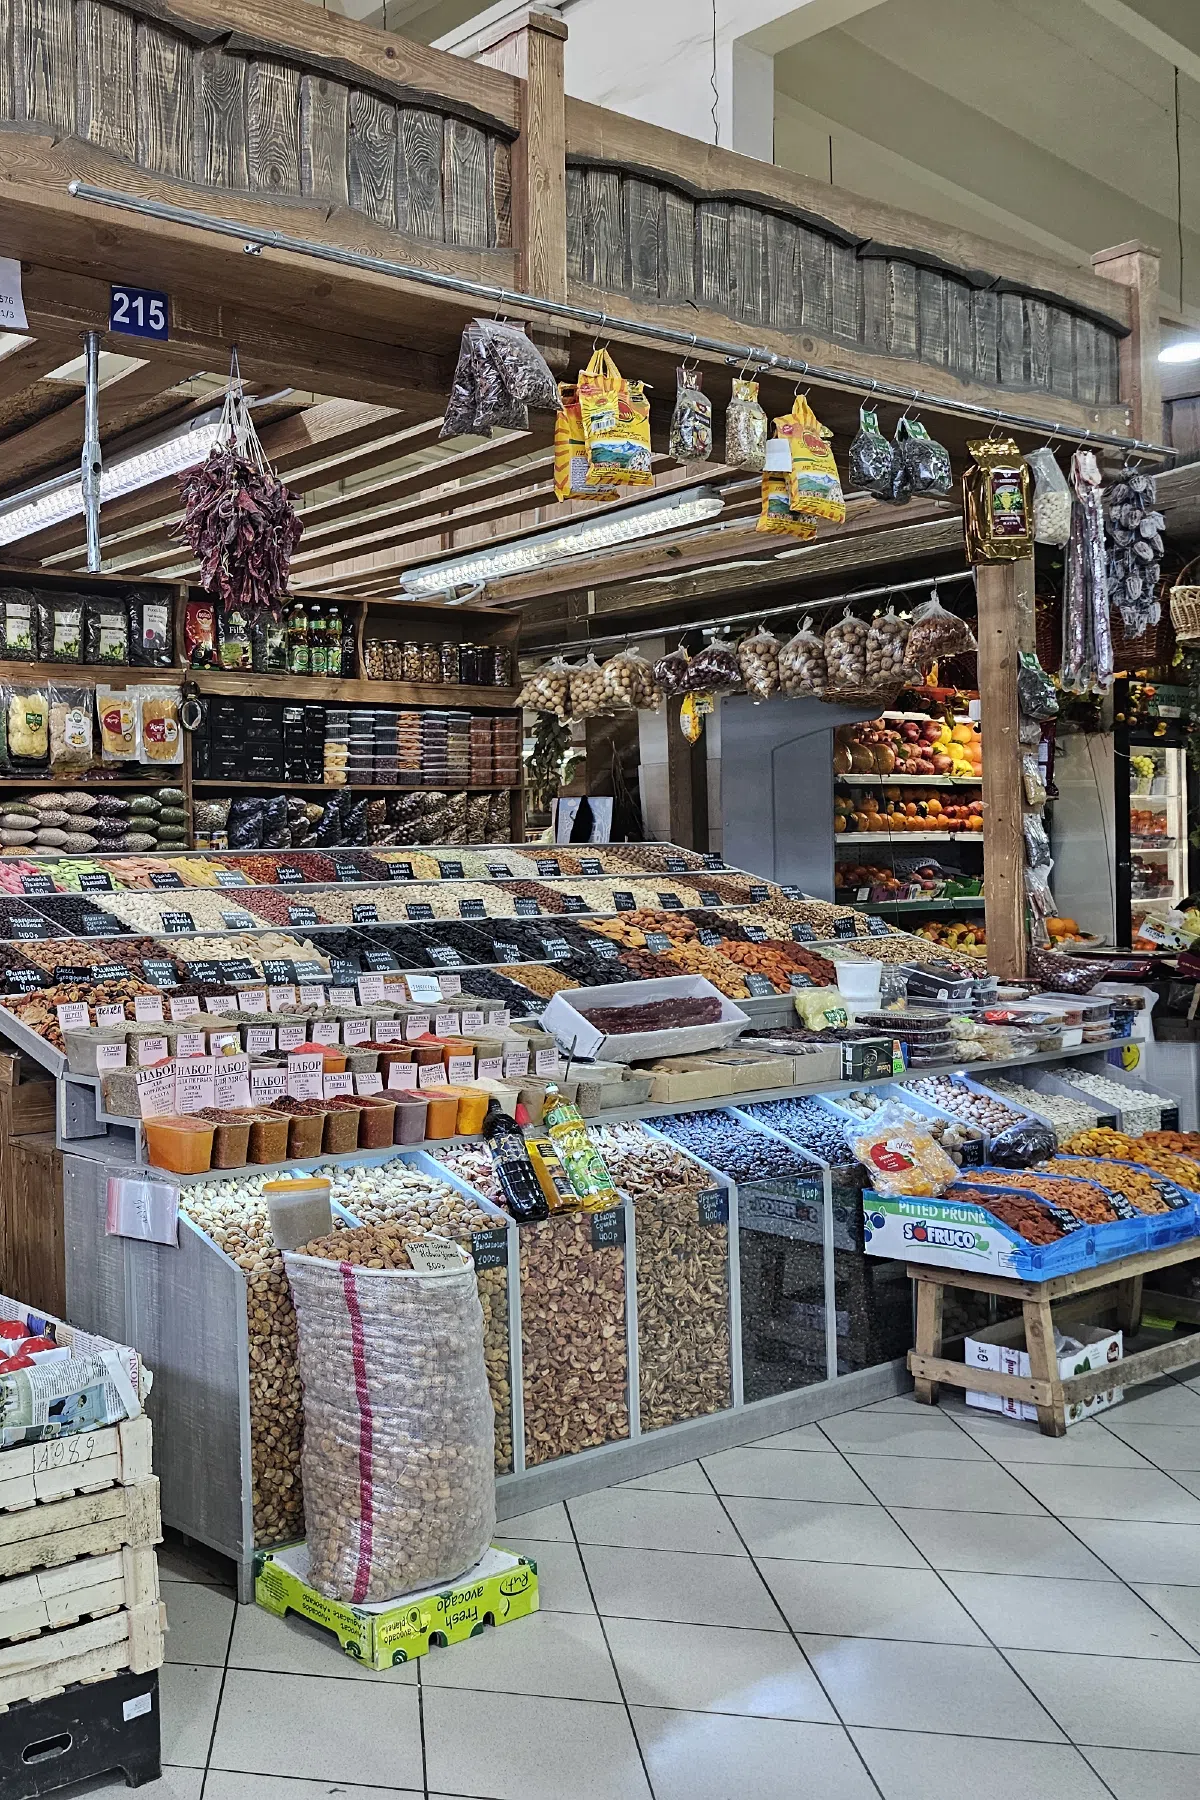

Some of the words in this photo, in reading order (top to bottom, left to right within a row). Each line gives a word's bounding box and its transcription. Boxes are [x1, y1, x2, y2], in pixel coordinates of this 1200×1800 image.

[113, 292, 165, 330] 215
[139, 1063, 177, 1082] НАБОР
[177, 1064, 213, 1076] НАБОР
[214, 1061, 248, 1075] НАБОР
[289, 1061, 321, 1073] НАБОР
[253, 1076, 287, 1087] НАБОР
[898, 1201, 938, 1217] PITTED
[903, 1223, 976, 1249] SOFRUCO
[437, 1586, 484, 1612] avocado
[445, 1605, 479, 1630] Fresh
[384, 1628, 411, 1645] avocado
